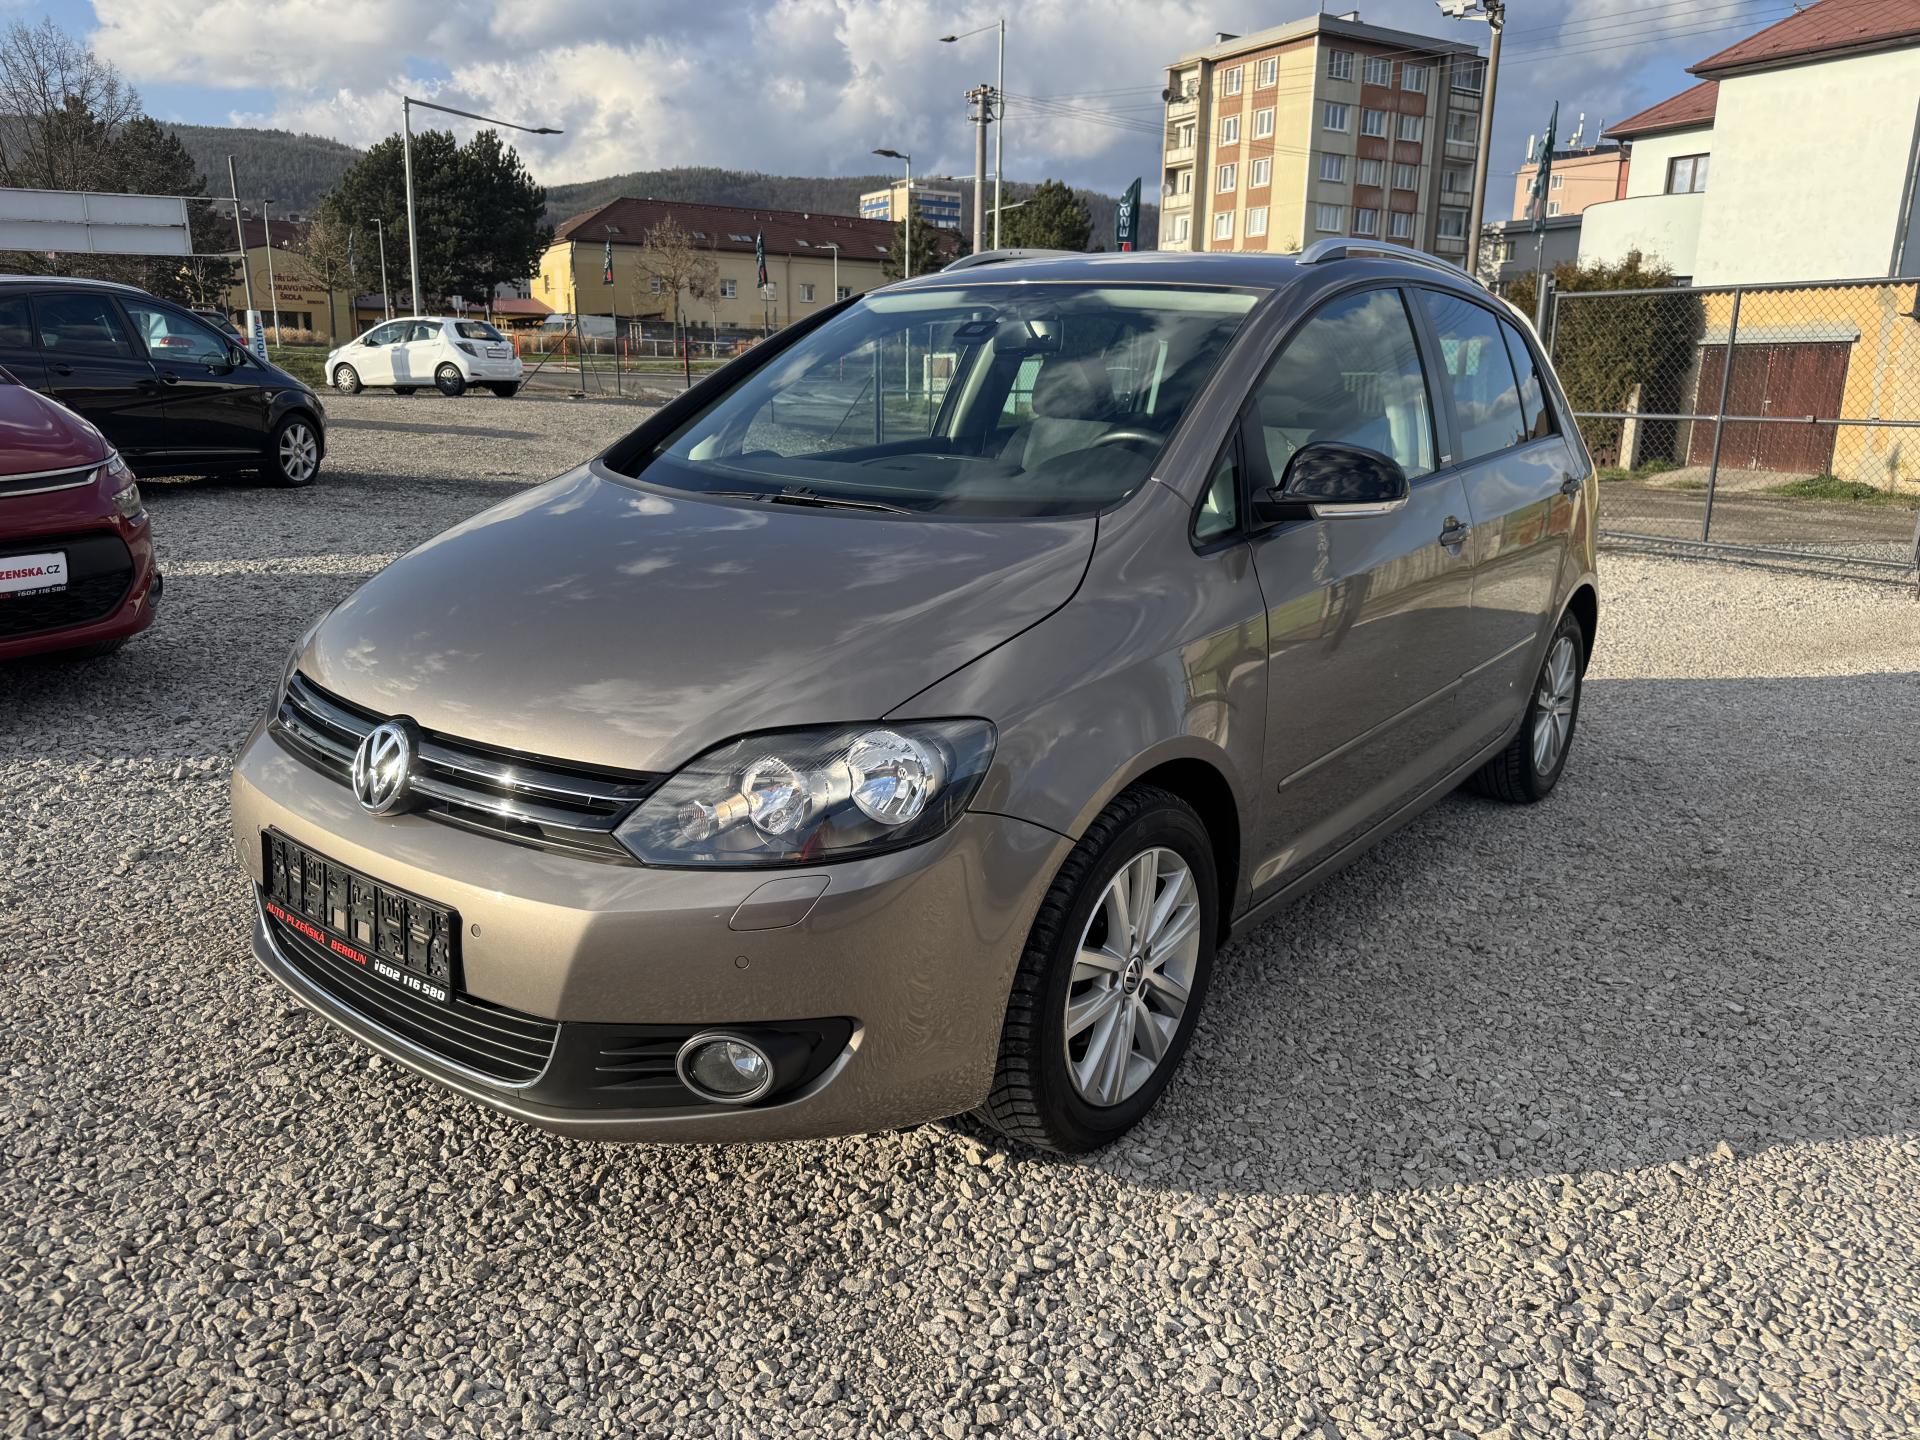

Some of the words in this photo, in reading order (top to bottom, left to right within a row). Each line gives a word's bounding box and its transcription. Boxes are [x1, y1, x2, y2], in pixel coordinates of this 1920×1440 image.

[266, 902, 286, 920] AUTO
[330, 939, 368, 966] BEROUN
[379, 963, 401, 981] 602
[402, 975, 422, 991] 116
[421, 983, 446, 1001] 580
